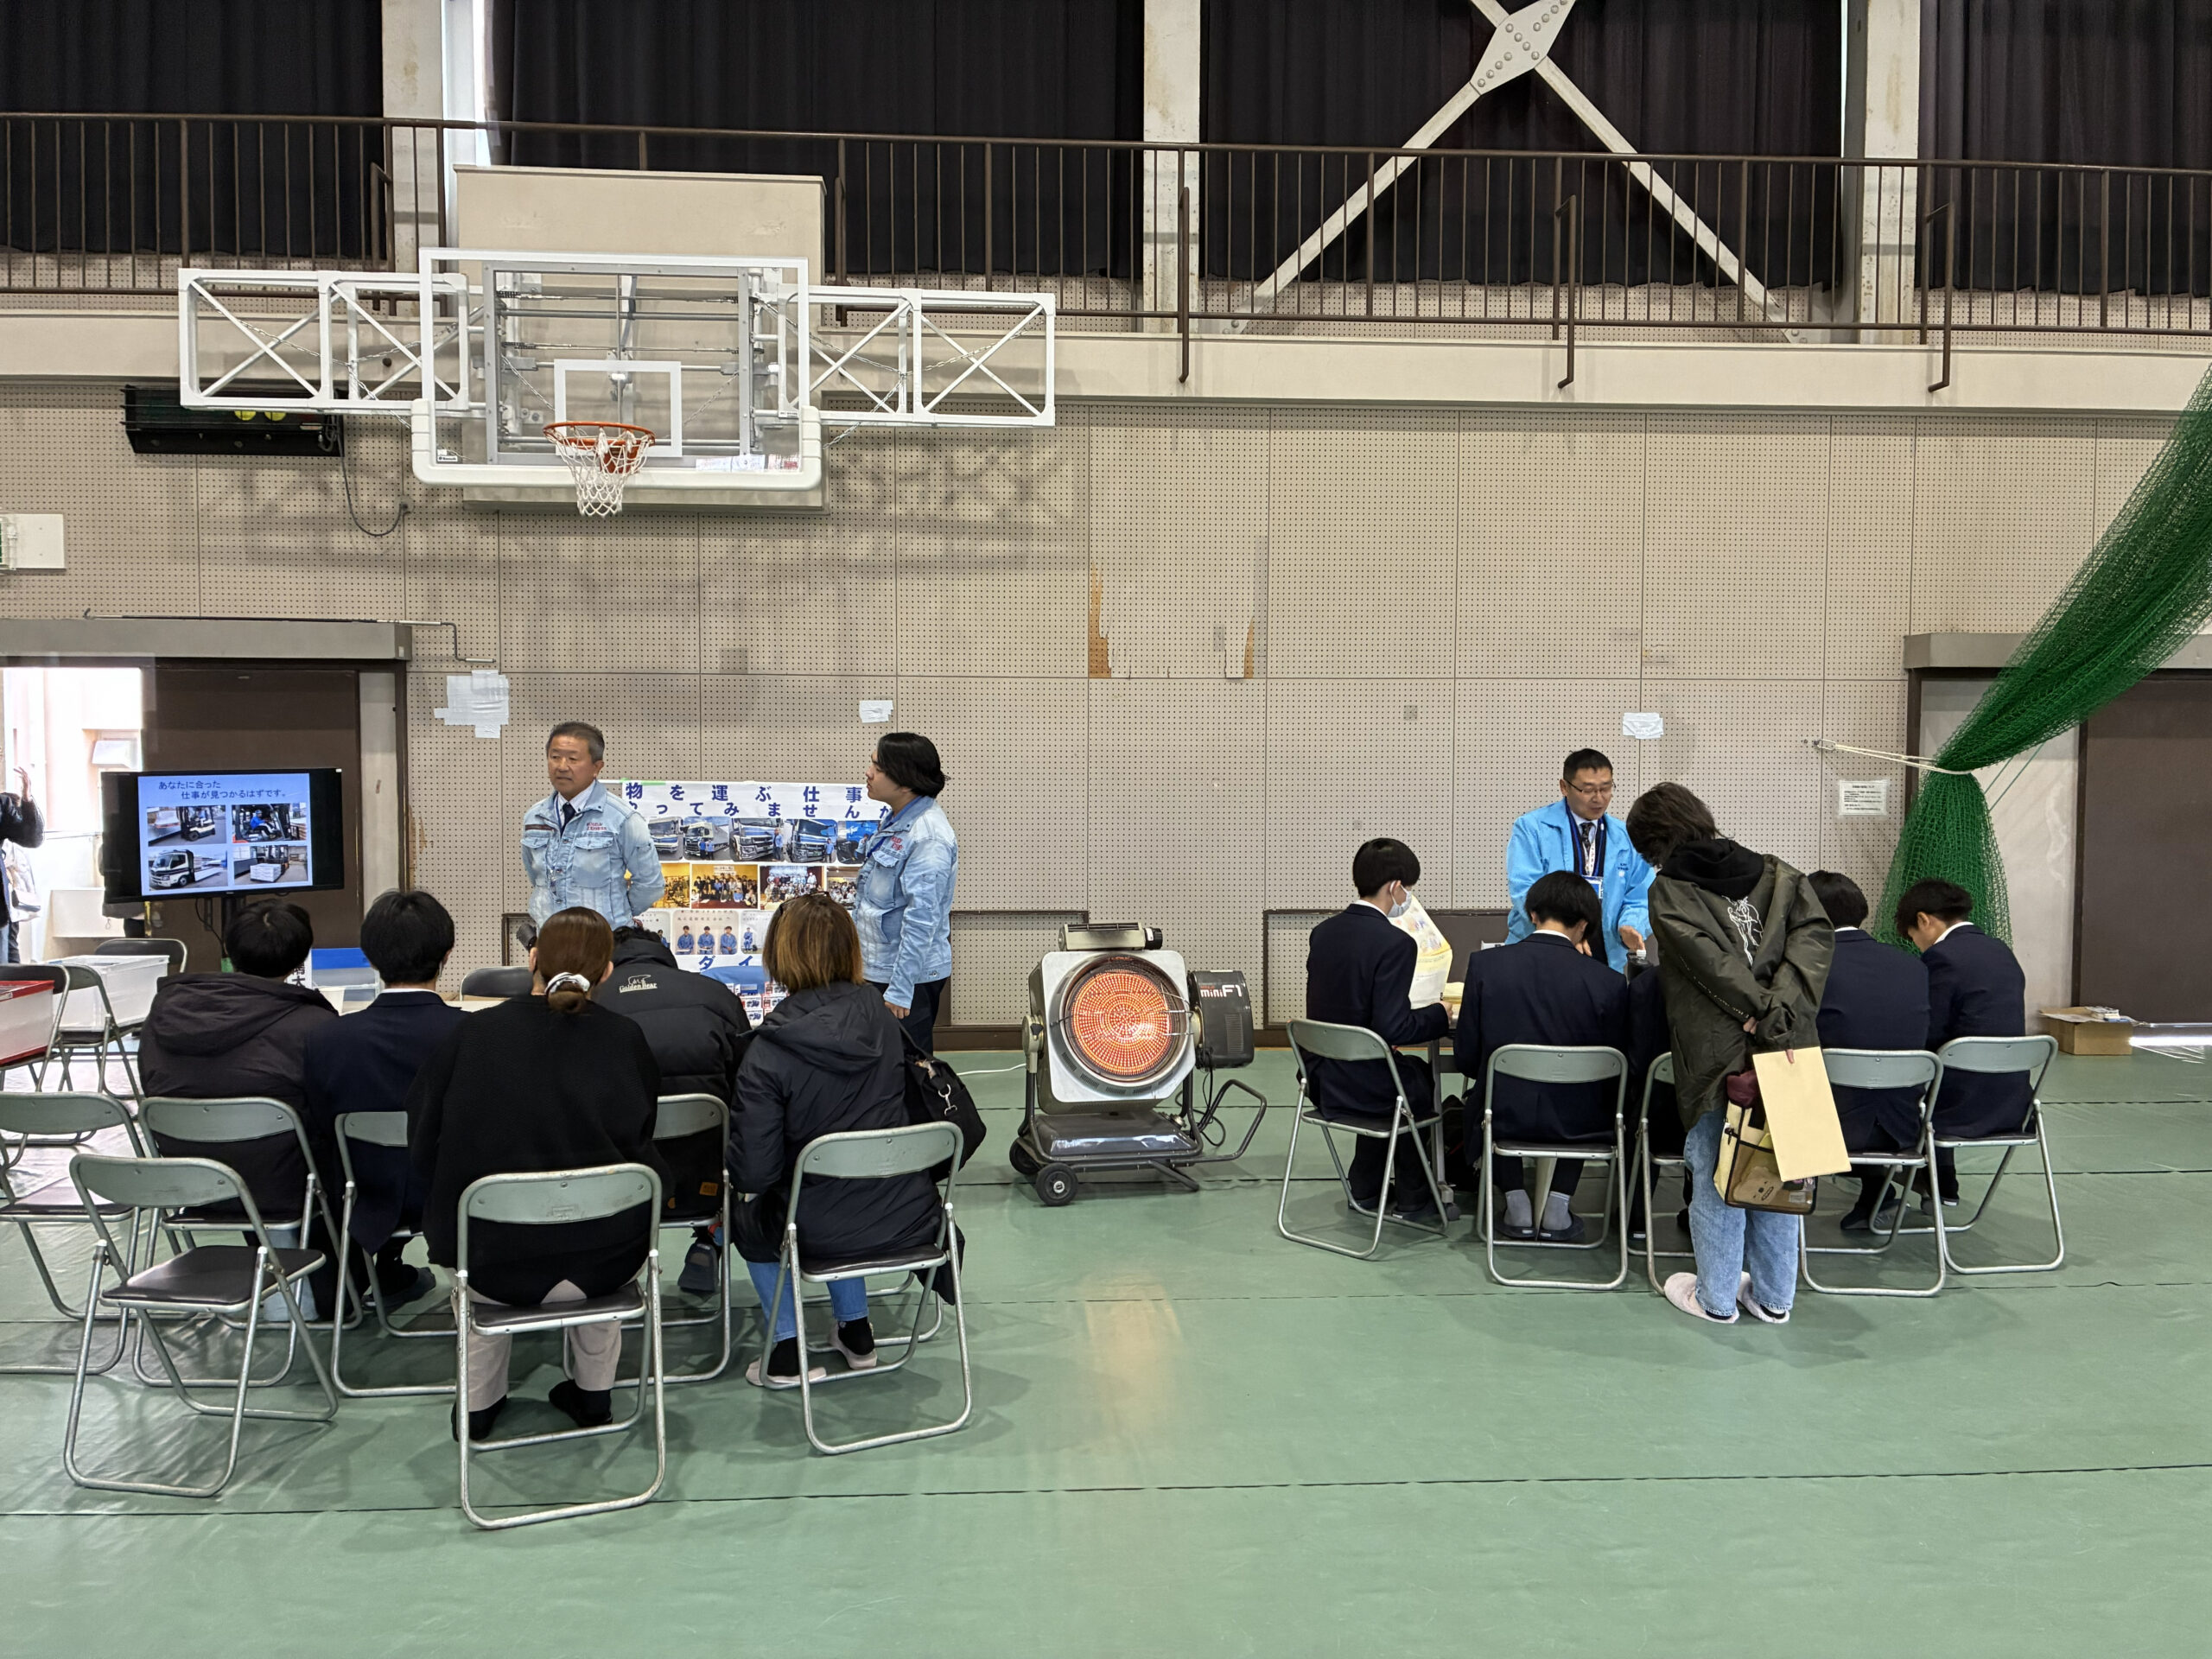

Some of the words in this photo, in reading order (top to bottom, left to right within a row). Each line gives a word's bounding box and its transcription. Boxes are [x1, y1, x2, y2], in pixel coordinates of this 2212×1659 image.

[159, 780, 221, 790] あなたに合った
[181, 789, 286, 800] 仕事が見つかるはずです。
